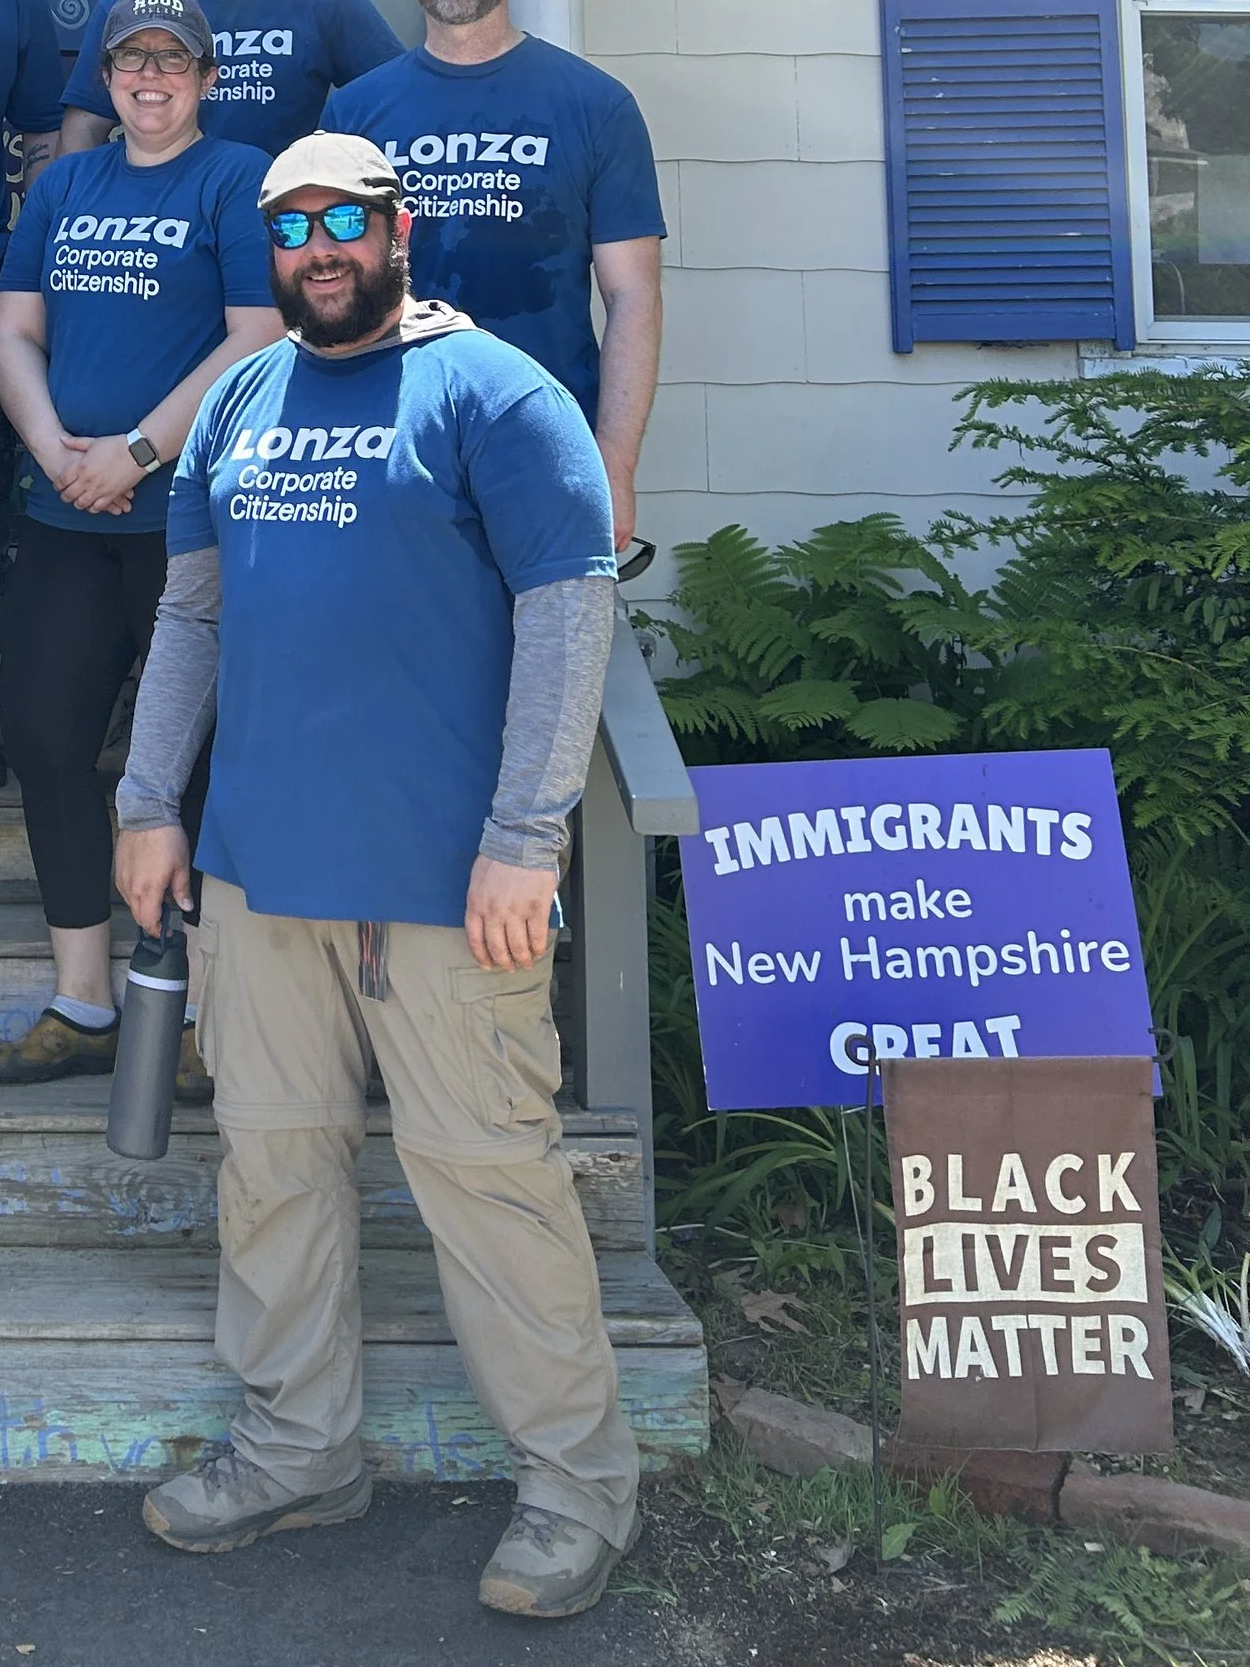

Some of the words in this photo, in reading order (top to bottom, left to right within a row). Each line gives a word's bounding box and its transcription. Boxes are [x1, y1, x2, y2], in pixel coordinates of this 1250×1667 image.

[212, 29, 293, 58] nza
[218, 60, 273, 80] orate
[205, 81, 276, 105] enship
[385, 132, 549, 166] Lonza
[402, 169, 521, 196] Corporate
[401, 193, 524, 222] Citizenship
[53, 215, 190, 249] Lonza
[55, 245, 159, 270] Corporate
[50, 269, 160, 300] Citizenship
[231, 425, 398, 461] Lonza
[238, 464, 358, 497] Corporate
[229, 494, 358, 528] Citizenship
[704, 802, 1093, 876] IMMIGRANTS
[843, 879, 973, 923] make
[704, 941, 822, 987] New
[841, 929, 1132, 987] Hampshire
[900, 1150, 1142, 1217] BLACK
[921, 1233, 1123, 1293] LIVES
[906, 1313, 1155, 1381] MATTER
